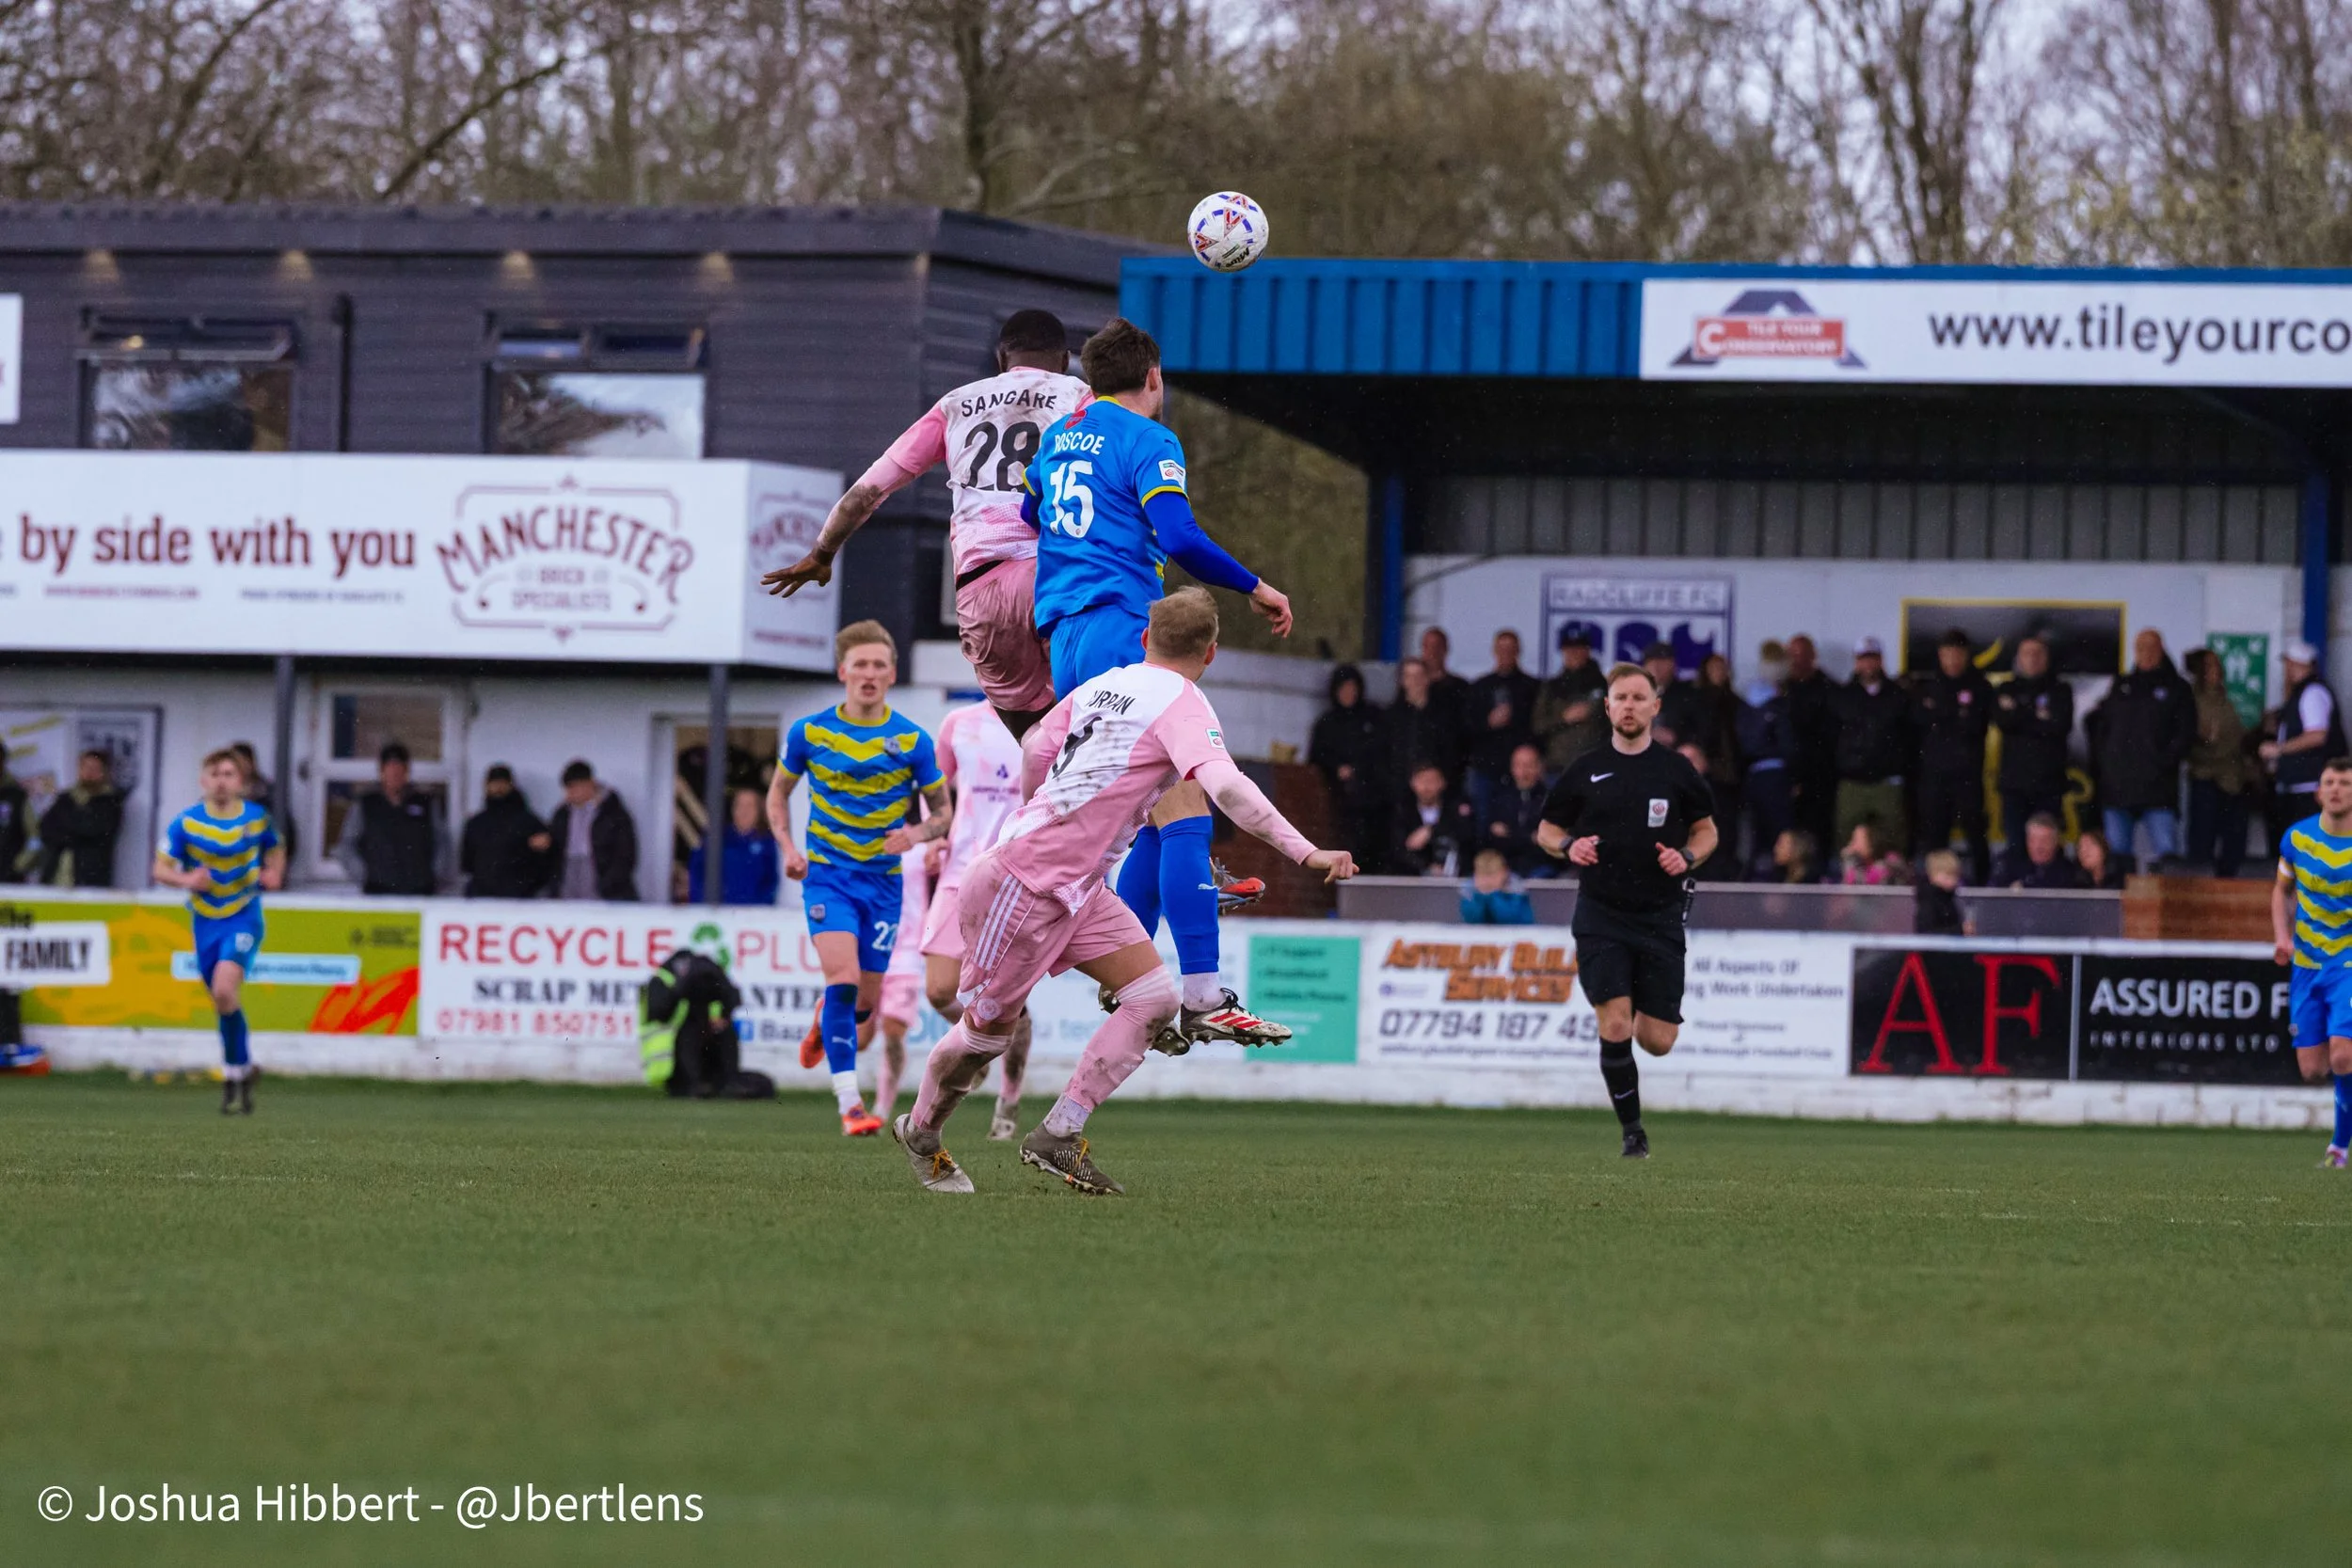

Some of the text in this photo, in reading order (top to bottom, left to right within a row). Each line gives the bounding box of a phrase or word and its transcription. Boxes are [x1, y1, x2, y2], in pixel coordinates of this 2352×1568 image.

[1929, 304, 2351, 365] www.tileyourco
[961, 389, 1057, 418] SANGARE
[964, 420, 1041, 492] 28
[1055, 432, 1105, 455] ROSCOE
[1050, 460, 1095, 539] 15
[20, 514, 417, 580] by side with you
[435, 504, 694, 605] MANCHESTER
[5, 939, 93, 973] FAMILY
[438, 923, 675, 969] RECYCLE
[737, 929, 821, 974] PLU
[474, 978, 578, 1005] SCRAP
[2090, 976, 2262, 1020] ASSURED
